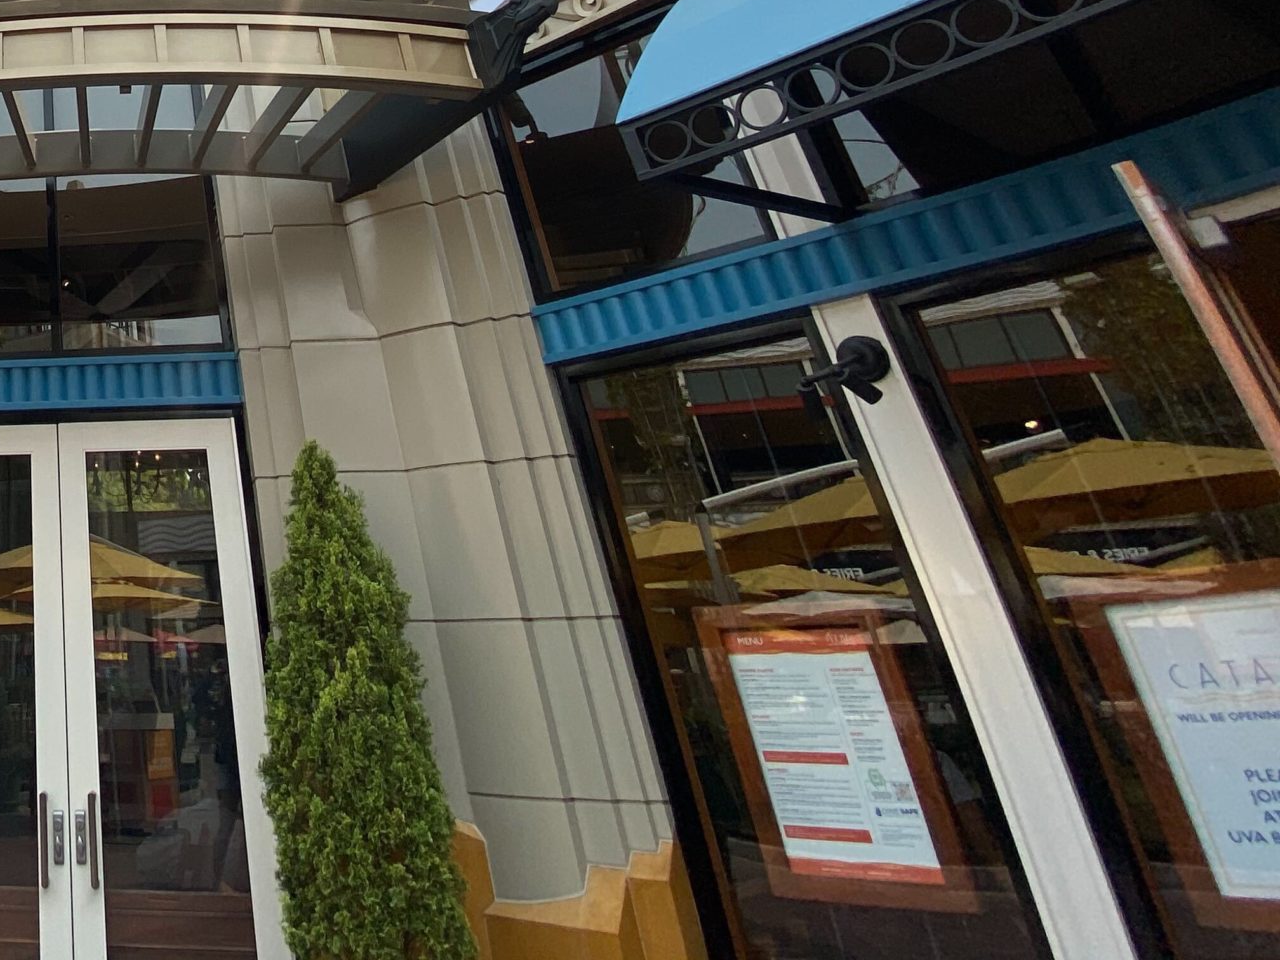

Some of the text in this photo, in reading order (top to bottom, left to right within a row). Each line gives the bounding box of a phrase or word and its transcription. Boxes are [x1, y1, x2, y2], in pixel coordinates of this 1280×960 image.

[1169, 658, 1276, 690] CATA
[1177, 712, 1209, 724] WILL
[1243, 768, 1280, 782] PLE
[1250, 789, 1280, 807] JOI
[1227, 829, 1269, 844] UVA
